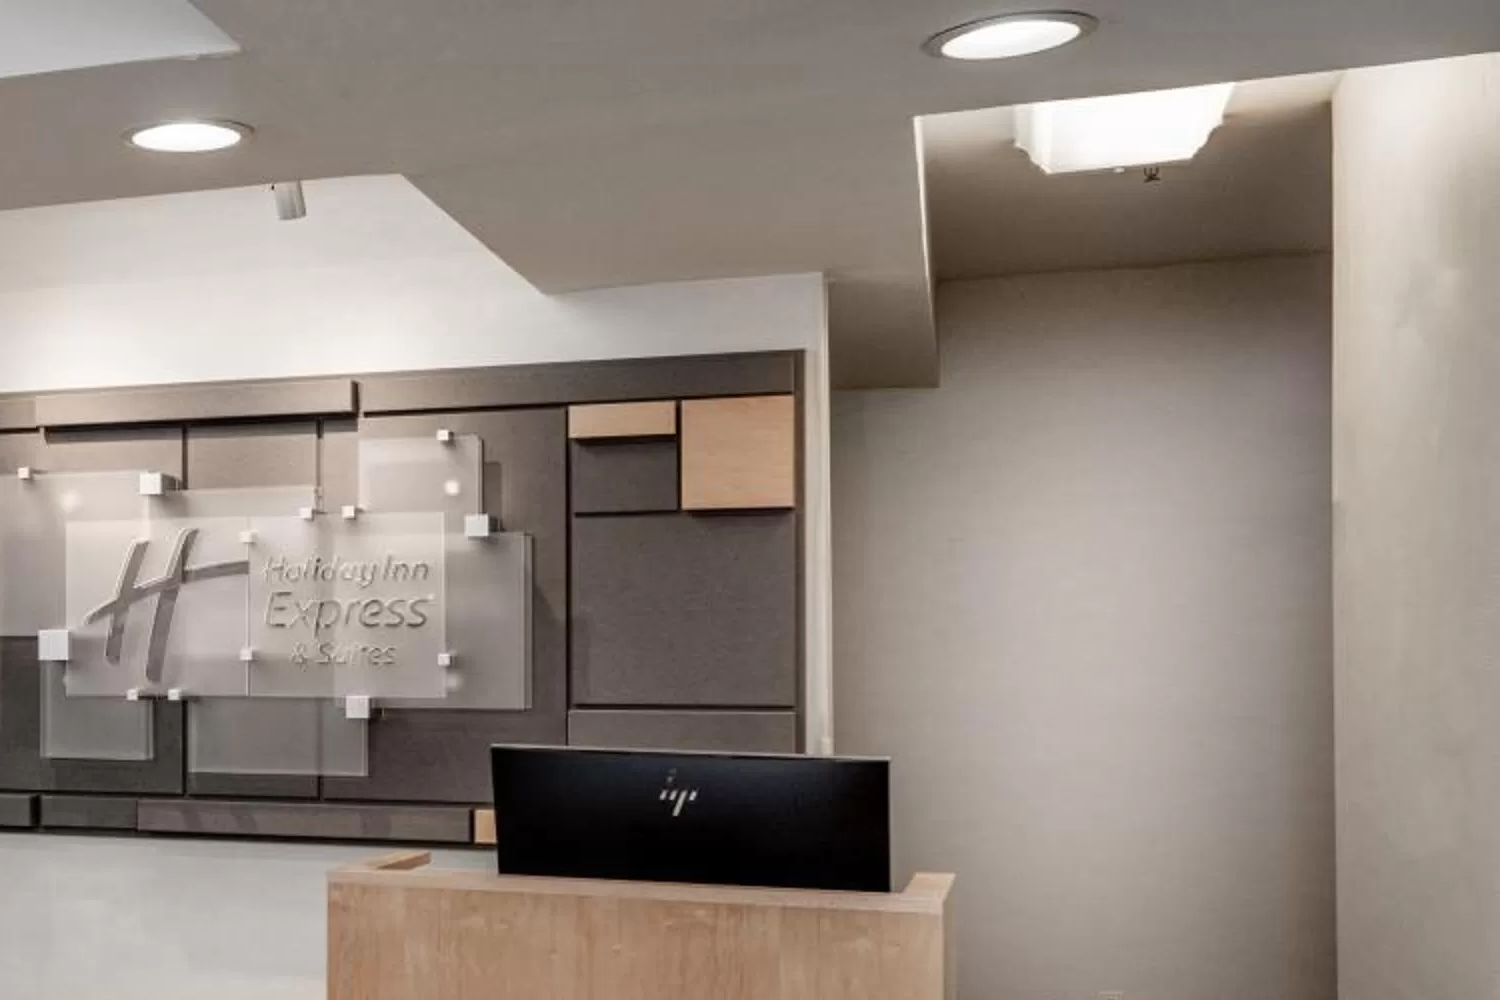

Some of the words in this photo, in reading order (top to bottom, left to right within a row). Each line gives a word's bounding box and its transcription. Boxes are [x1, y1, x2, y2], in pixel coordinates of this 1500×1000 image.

[261, 554, 377, 588] Holiday
[383, 554, 429, 582] Inn
[265, 591, 429, 640] Express
[290, 642, 309, 669] &
